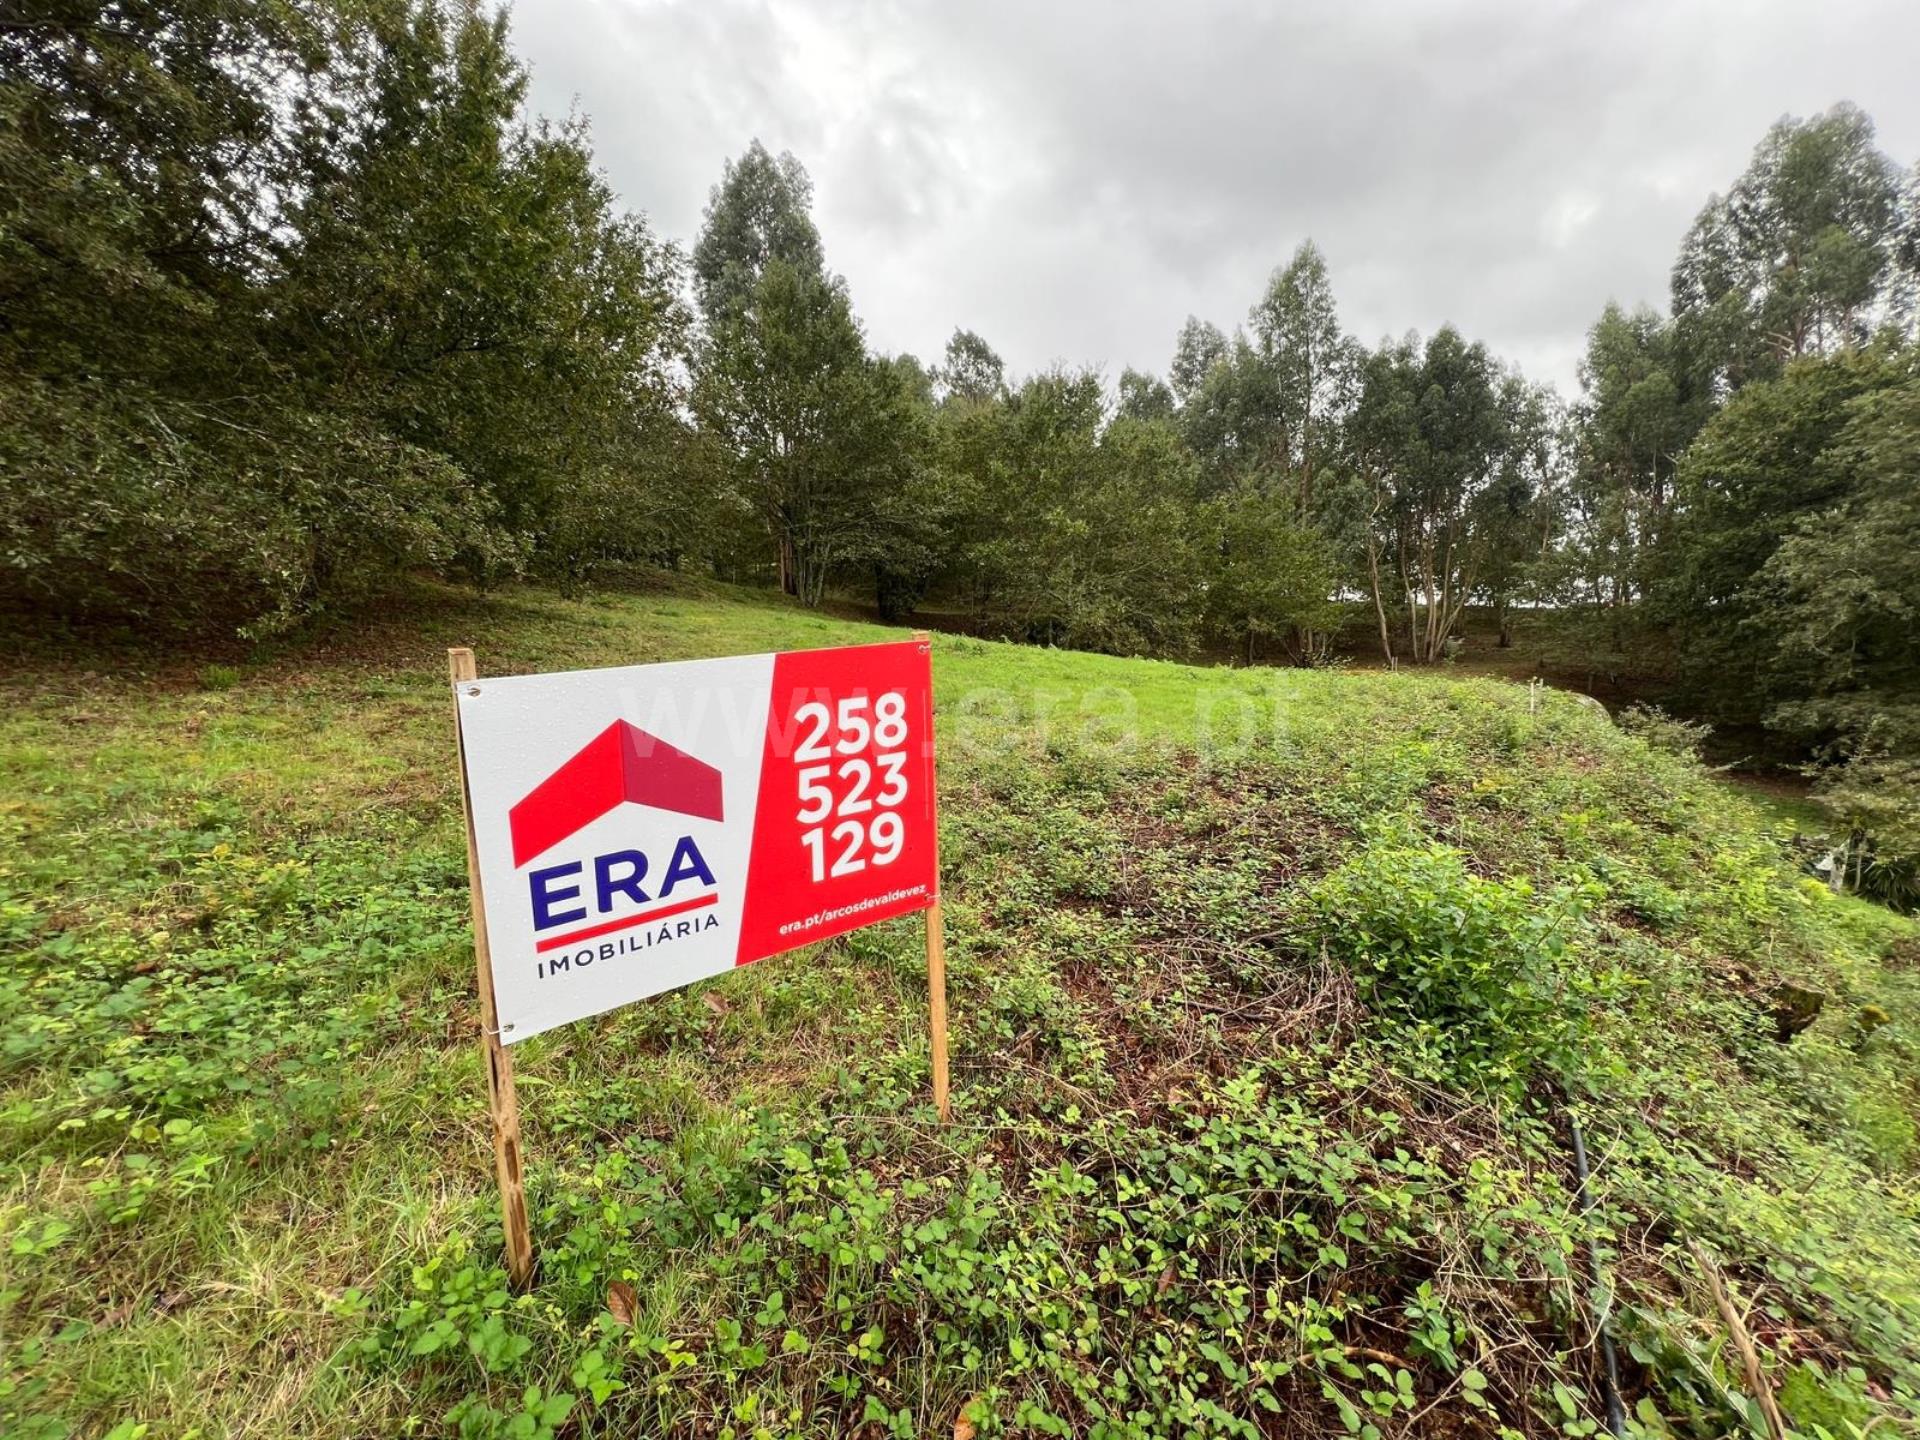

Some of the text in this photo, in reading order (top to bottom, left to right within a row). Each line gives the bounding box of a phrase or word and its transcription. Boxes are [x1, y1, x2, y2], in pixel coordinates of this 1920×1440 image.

[793, 691, 908, 762] 258
[796, 751, 909, 824] 523
[528, 835, 717, 932] ERA
[800, 811, 905, 884] 129
[778, 883, 927, 936] era.pt/arcosdevaldevez
[537, 913, 720, 979] IMOBILIÁRIA
